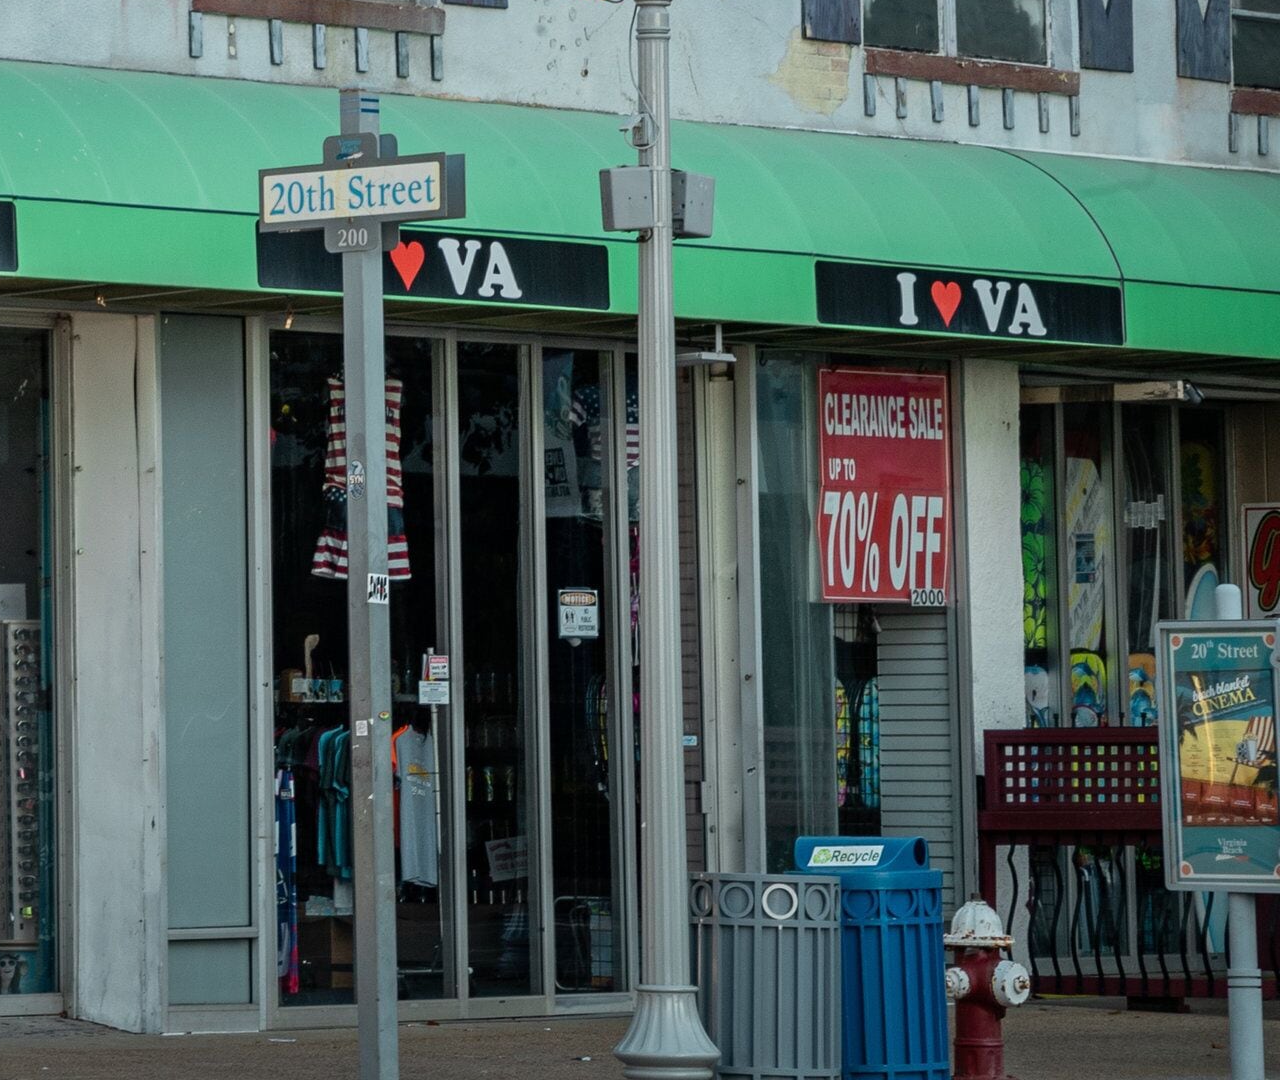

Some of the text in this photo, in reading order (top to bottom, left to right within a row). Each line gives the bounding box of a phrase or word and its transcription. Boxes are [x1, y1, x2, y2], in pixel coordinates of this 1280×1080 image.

[269, 174, 436, 216] 20th Street
[338, 228, 368, 247] 200
[437, 238, 523, 299] VA
[896, 272, 1048, 336] I VA
[824, 392, 943, 440] CLEARANCE SALE
[829, 458, 856, 481] UP TO
[824, 490, 943, 593] 70% OFF
[913, 589, 944, 605] 2000
[1191, 641, 1259, 659] 20th Street
[830, 850, 880, 865] Recycle
